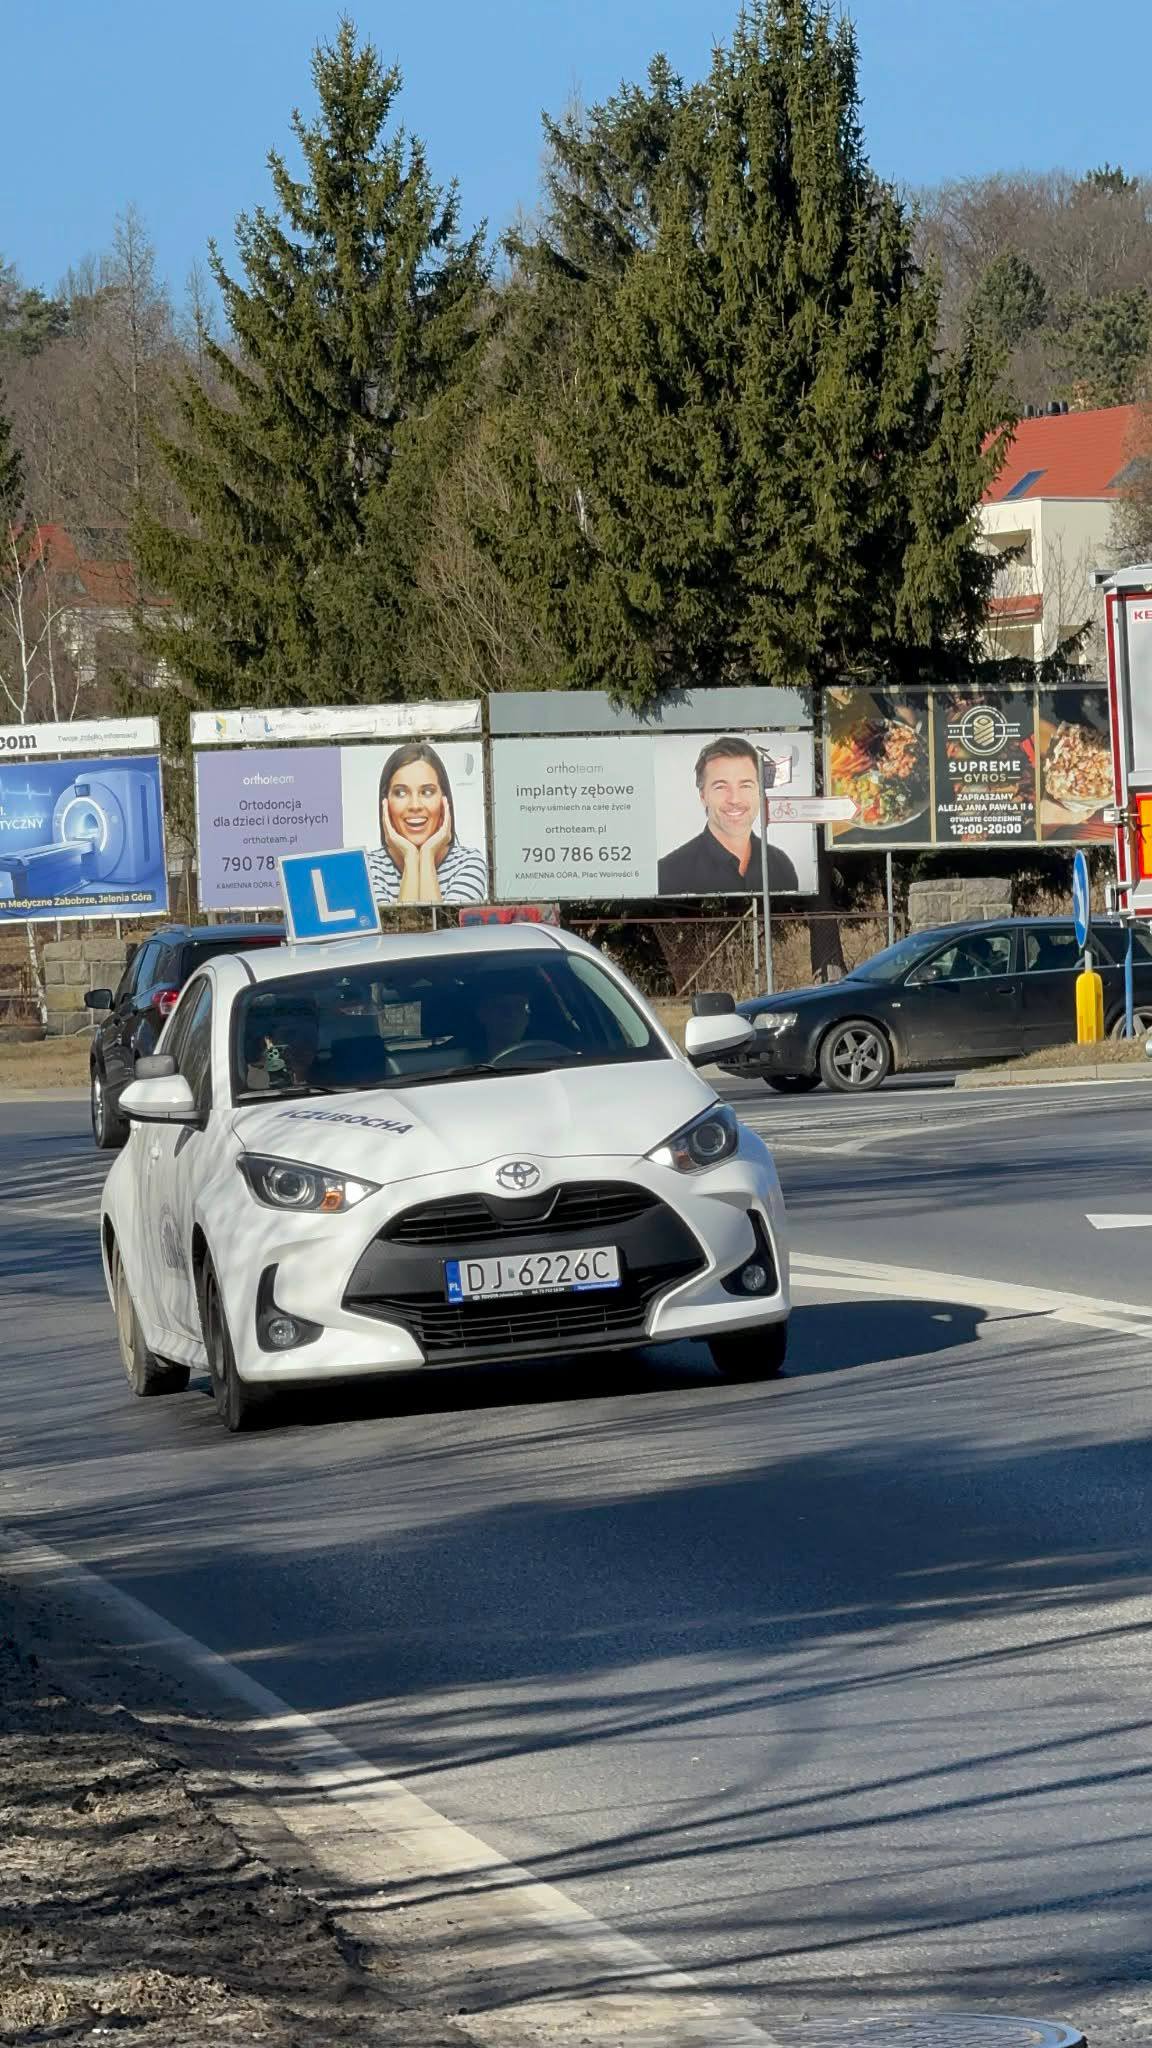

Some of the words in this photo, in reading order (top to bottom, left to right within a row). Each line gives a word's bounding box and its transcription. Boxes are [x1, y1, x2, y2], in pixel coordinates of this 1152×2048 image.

[546, 761, 604, 774] orthoteam
[949, 761, 1021, 773] SUPREME
[243, 772, 295, 785] orthoteam
[964, 773, 1007, 783] GYROS
[516, 784, 577, 799] implanty
[580, 783, 634, 798] zębowe
[957, 793, 1014, 801] ZAPRASZAMY
[239, 798, 302, 812] Ortodoncja
[520, 804, 545, 813] Piękny
[547, 803, 580, 811] uśmiech
[593, 803, 610, 811] całe
[611, 802, 631, 812] życie
[938, 804, 964, 812] ALEJA
[965, 803, 987, 811] JANA
[989, 802, 1018, 811] PAWŁA
[213, 816, 230, 827] dla
[232, 815, 265, 827] dzieci
[272, 813, 329, 826] dorosłych
[545, 824, 607, 835] orthoteam.pl
[950, 823, 1022, 835] 12:00-20:00
[243, 834, 298, 845] orthoteam.pl
[522, 847, 556, 863] 790
[560, 846, 594, 862] 786
[598, 846, 632, 861] 652
[222, 856, 253, 872] 790
[256, 855, 278, 871] 78
[515, 871, 554, 880] KAMIENNA
[8, 899, 52, 909] Medyczne
[54, 896, 98, 906] Zabobrze,
[98, 893, 130, 903] Jelenia
[131, 892, 152, 902] Góra
[311, 869, 356, 922] L
[466, 1260, 503, 1292] DJ
[518, 1251, 610, 1286] 6226C
[448, 1282, 460, 1292] PL
